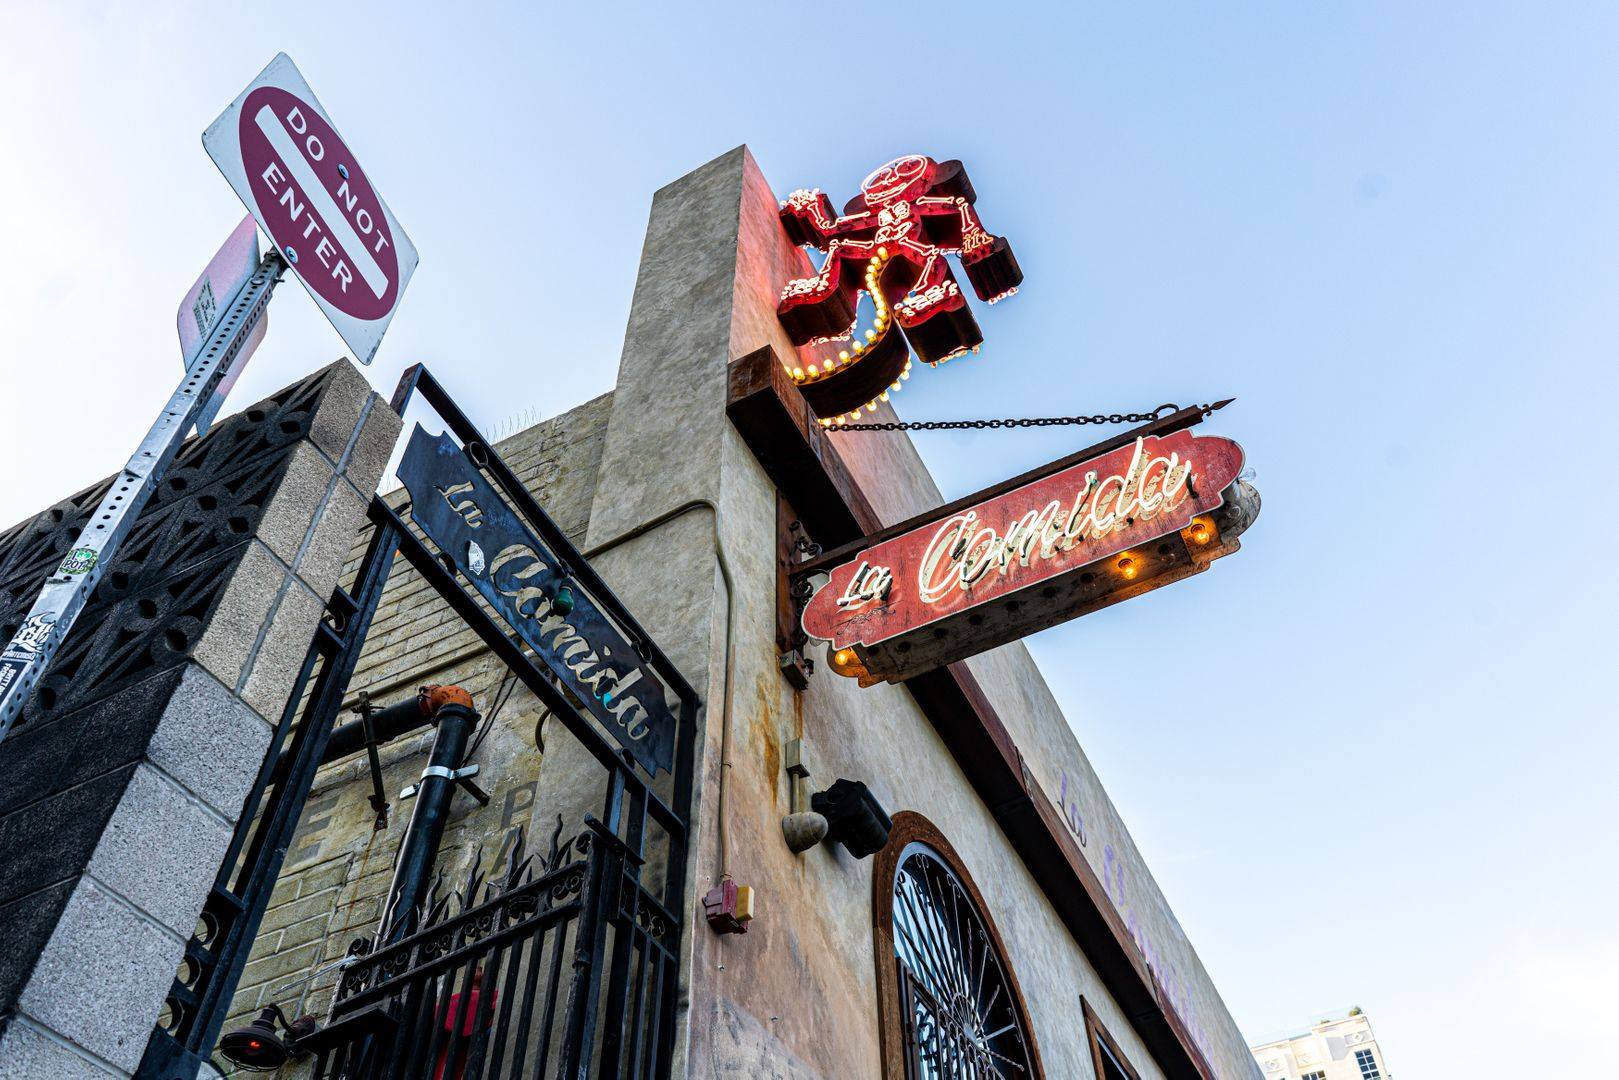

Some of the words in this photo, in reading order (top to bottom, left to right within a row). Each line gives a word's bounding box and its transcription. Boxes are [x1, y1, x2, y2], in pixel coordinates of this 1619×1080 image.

[261, 161, 353, 293] ENTER
[286, 106, 325, 162] DO
[336, 181, 390, 254] NOT
[836, 560, 895, 611] La
[917, 435, 1196, 603] Comida
[433, 480, 484, 530] La
[489, 543, 651, 741] Comida
